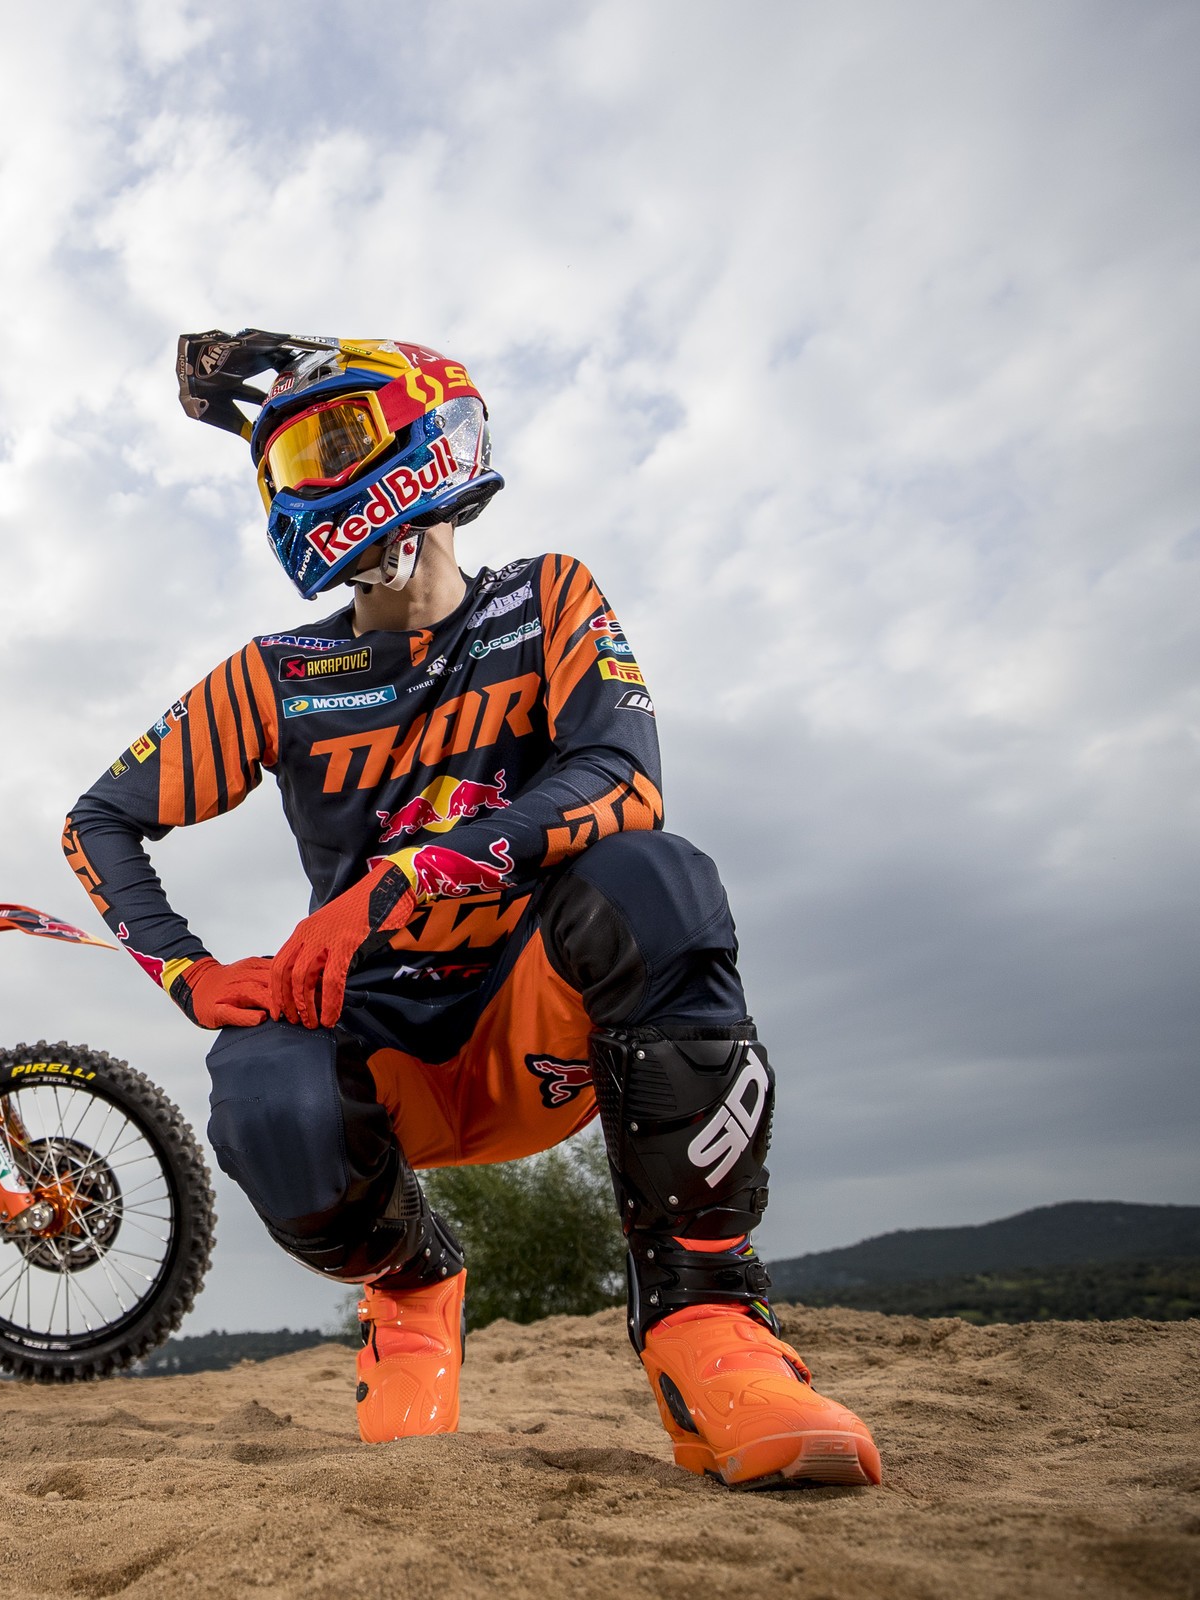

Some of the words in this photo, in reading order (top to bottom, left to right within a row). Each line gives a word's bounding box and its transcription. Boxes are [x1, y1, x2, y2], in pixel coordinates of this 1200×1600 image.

[306, 482, 399, 566] Red
[383, 435, 459, 510] Bull
[298, 546, 314, 581] Airoh
[307, 650, 368, 676] AKRAPOVIČ
[313, 690, 388, 709] MOTOREX
[309, 672, 544, 794] THOR
[10, 1063, 96, 1081] PIRELLI
